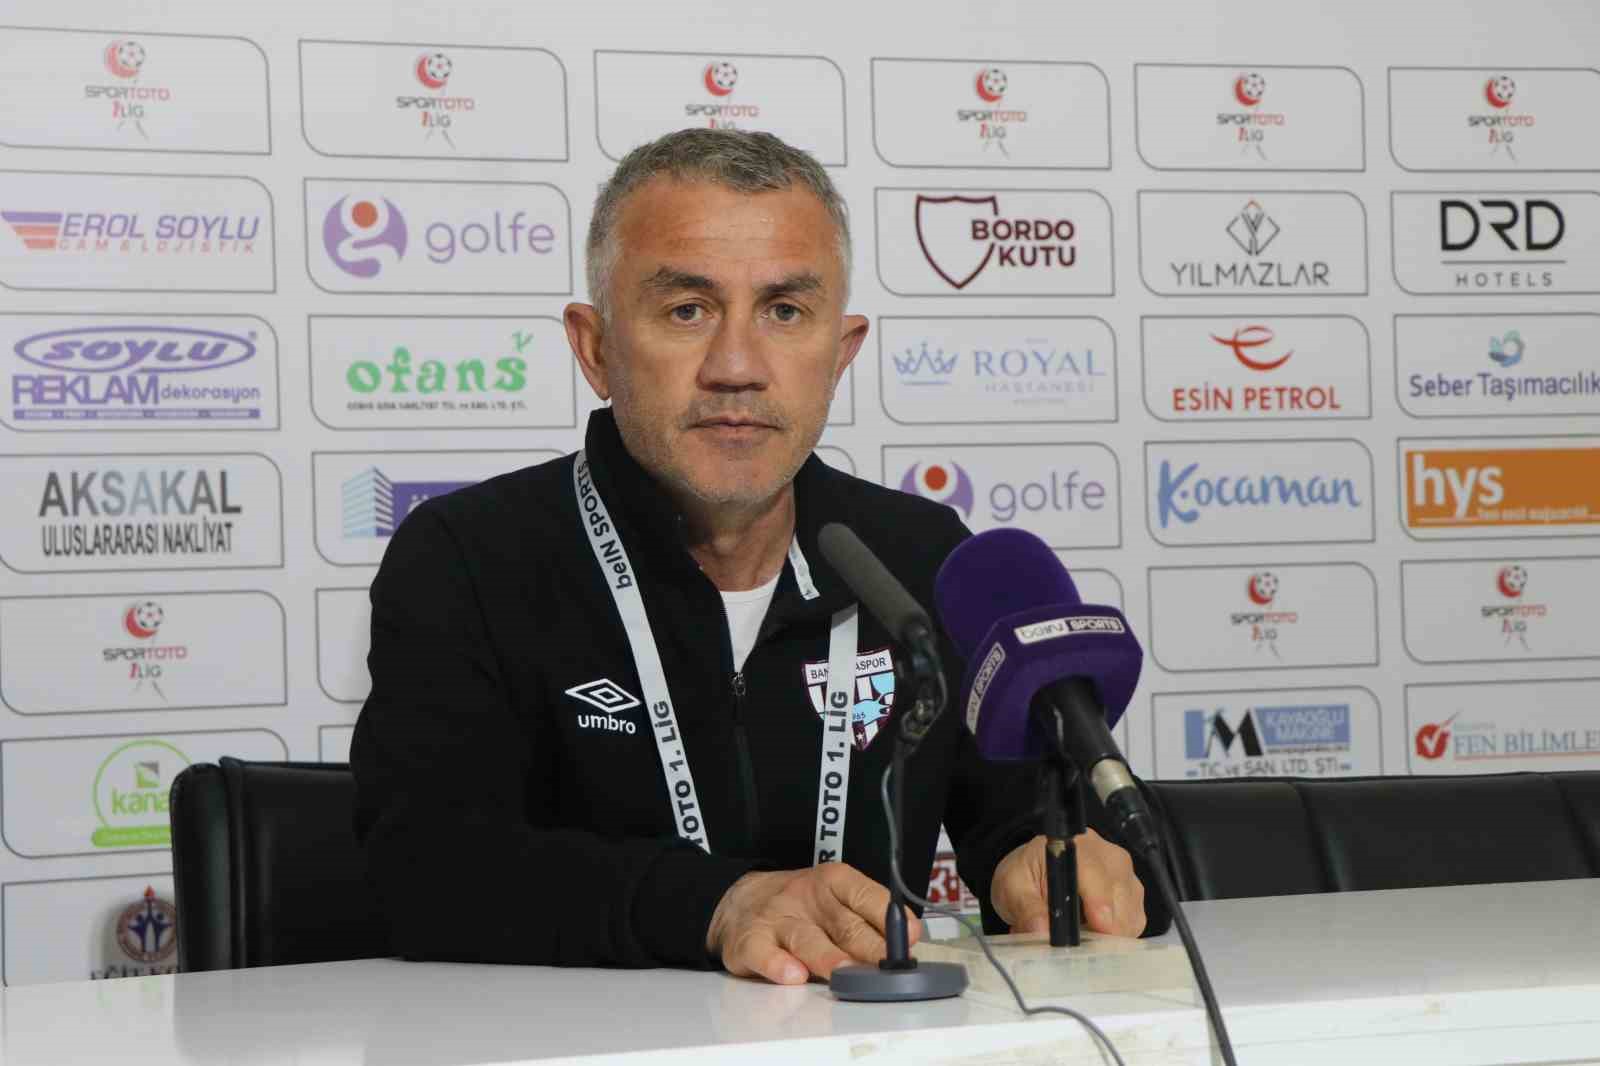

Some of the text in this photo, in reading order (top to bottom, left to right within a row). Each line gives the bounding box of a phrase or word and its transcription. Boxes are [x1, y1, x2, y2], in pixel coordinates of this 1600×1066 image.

[63, 213, 260, 241] EROL SOYLU
[425, 211, 555, 264] golfe
[971, 219, 1075, 241] BORDO
[1440, 200, 1565, 251] DRD
[998, 247, 1076, 267] KUTU
[1170, 262, 1330, 287] YILMAZLAR
[1456, 272, 1553, 287] HOTELS
[974, 349, 1106, 376] ROYAL
[12, 373, 261, 405] REKLAM dekorasyon
[1172, 382, 1341, 411] ESİN PETROL
[1409, 374, 1473, 398] Seber
[38, 469, 242, 517] AKSAKAL
[989, 471, 1106, 522] golfe
[1412, 453, 1505, 520] hys
[42, 517, 232, 556] ULUSLARARASI NAKLİYAT
[578, 715, 636, 734] umbro
[653, 700, 677, 743] LİG
[828, 690, 848, 733] LİG
[112, 788, 169, 815] kana
[820, 770, 843, 841] TOTO
